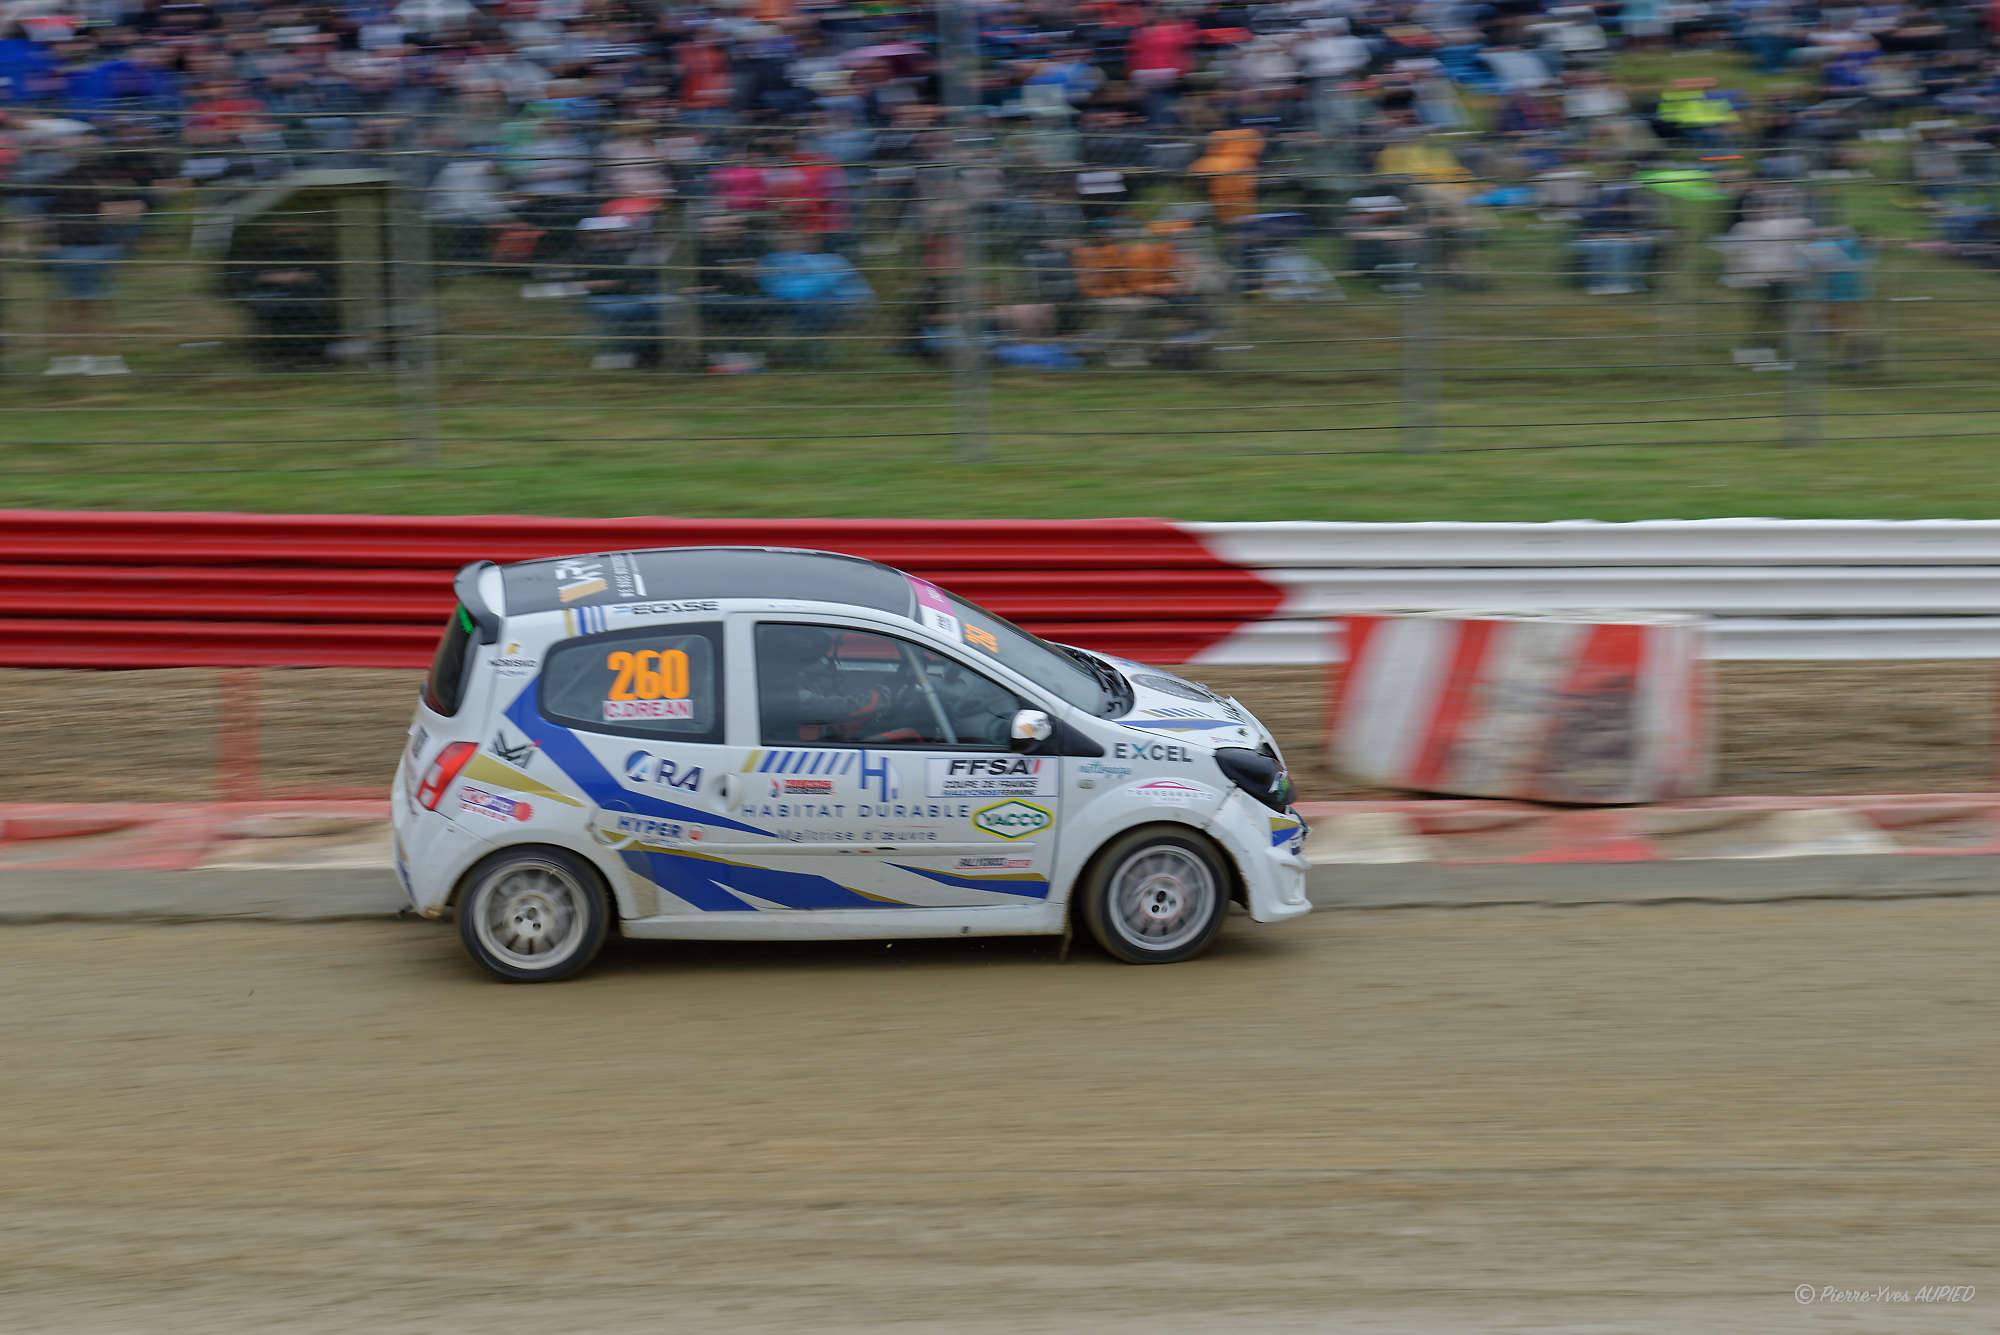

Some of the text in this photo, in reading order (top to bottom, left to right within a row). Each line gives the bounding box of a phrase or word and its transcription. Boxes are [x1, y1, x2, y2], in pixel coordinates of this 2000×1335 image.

[607, 649, 690, 701] 260
[604, 701, 690, 719] C.DREAN
[1114, 738, 1193, 763] EXCEL
[947, 759, 1029, 775] FFSA
[740, 803, 970, 819] HABITAT DURABLE
[983, 813, 1045, 826] YACCO
[617, 816, 682, 838] HYPER
